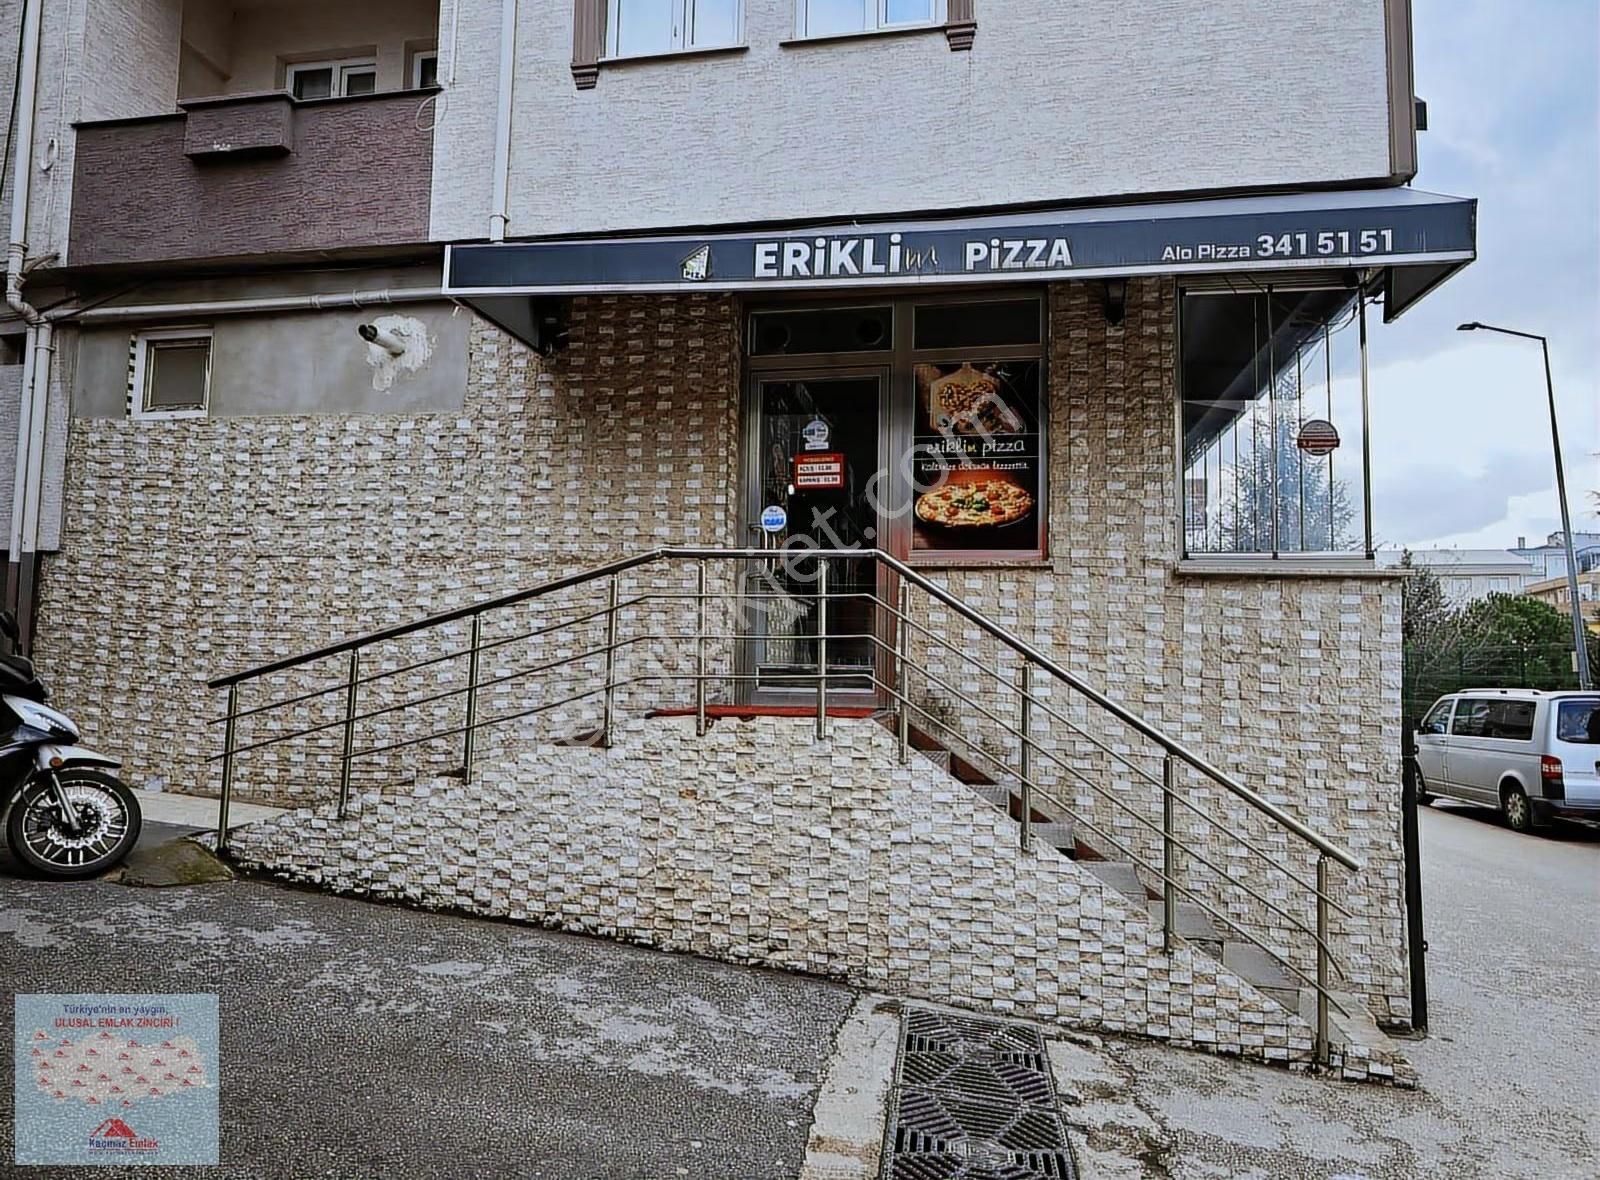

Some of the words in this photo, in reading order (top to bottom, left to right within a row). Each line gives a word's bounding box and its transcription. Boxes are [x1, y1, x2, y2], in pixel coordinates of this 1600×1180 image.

[965, 239, 1073, 270] PiZZA
[1161, 246, 1193, 261] Alo
[1198, 244, 1250, 260] Pizza
[1256, 232, 1308, 257] 341
[1317, 231, 1350, 254] 51
[1360, 229, 1393, 252] 51
[982, 439, 1025, 457] pizza
